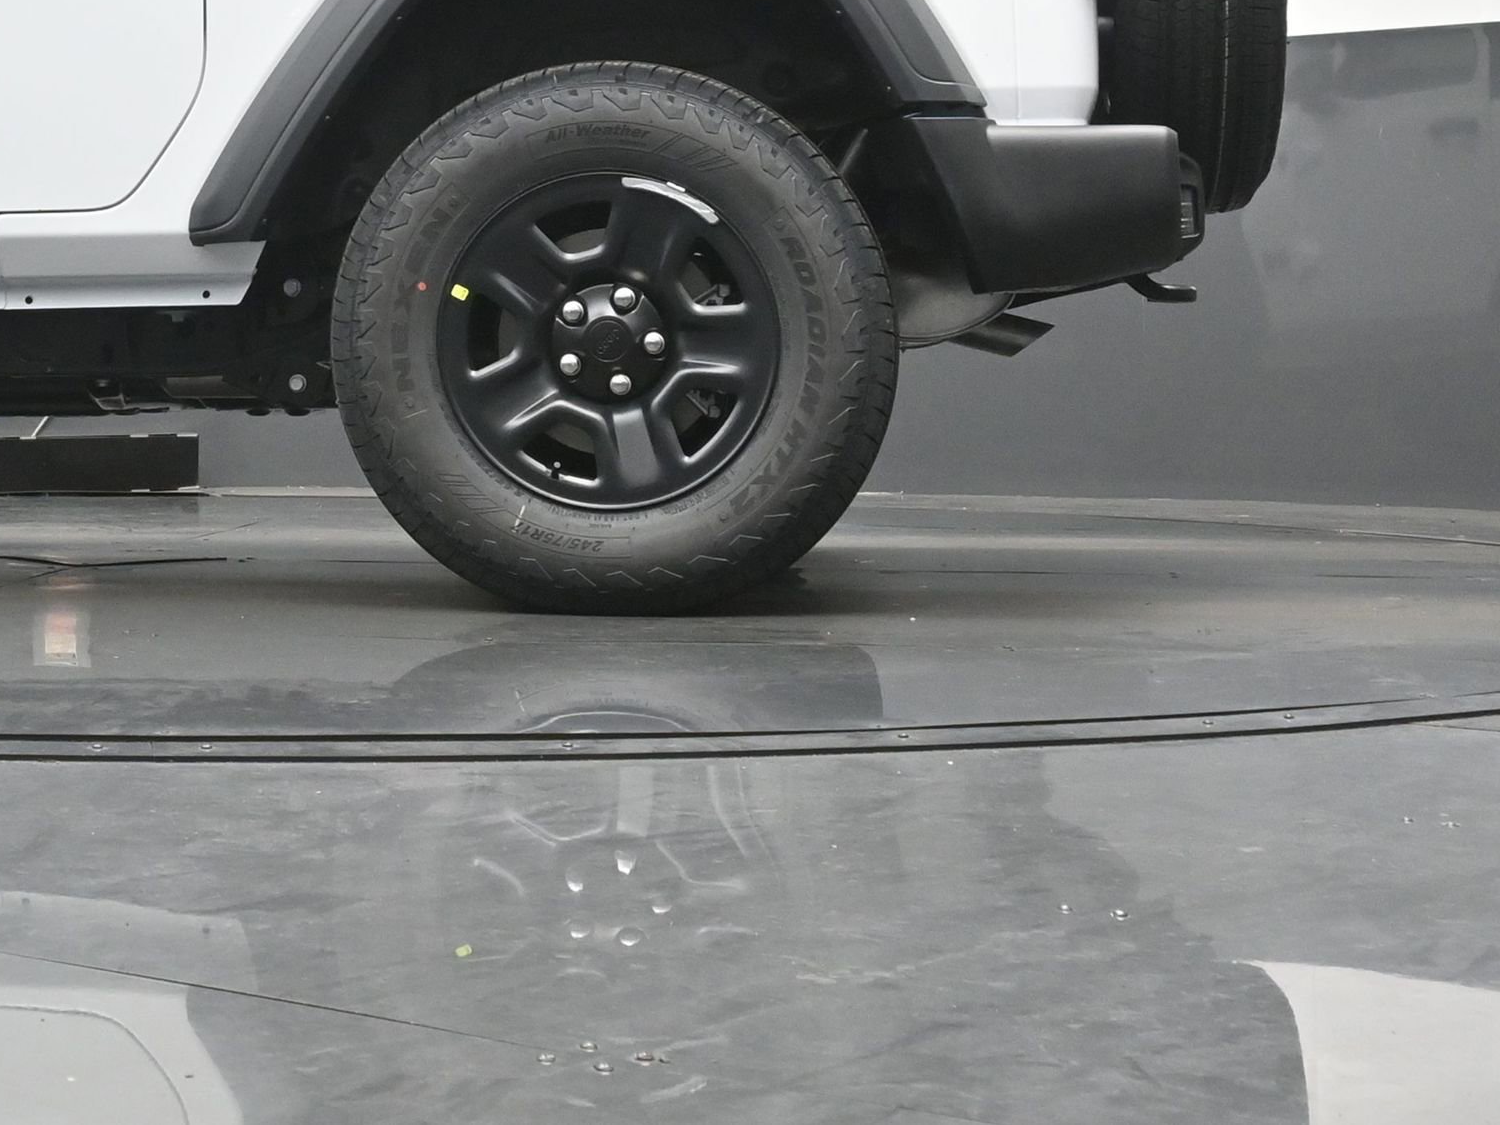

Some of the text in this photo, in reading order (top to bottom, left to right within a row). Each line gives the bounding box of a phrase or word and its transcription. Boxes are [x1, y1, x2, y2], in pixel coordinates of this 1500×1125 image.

[545, 123, 651, 144] All-Weather
[390, 206, 452, 392] NEXEN
[780, 235, 828, 418] ROADIAN
